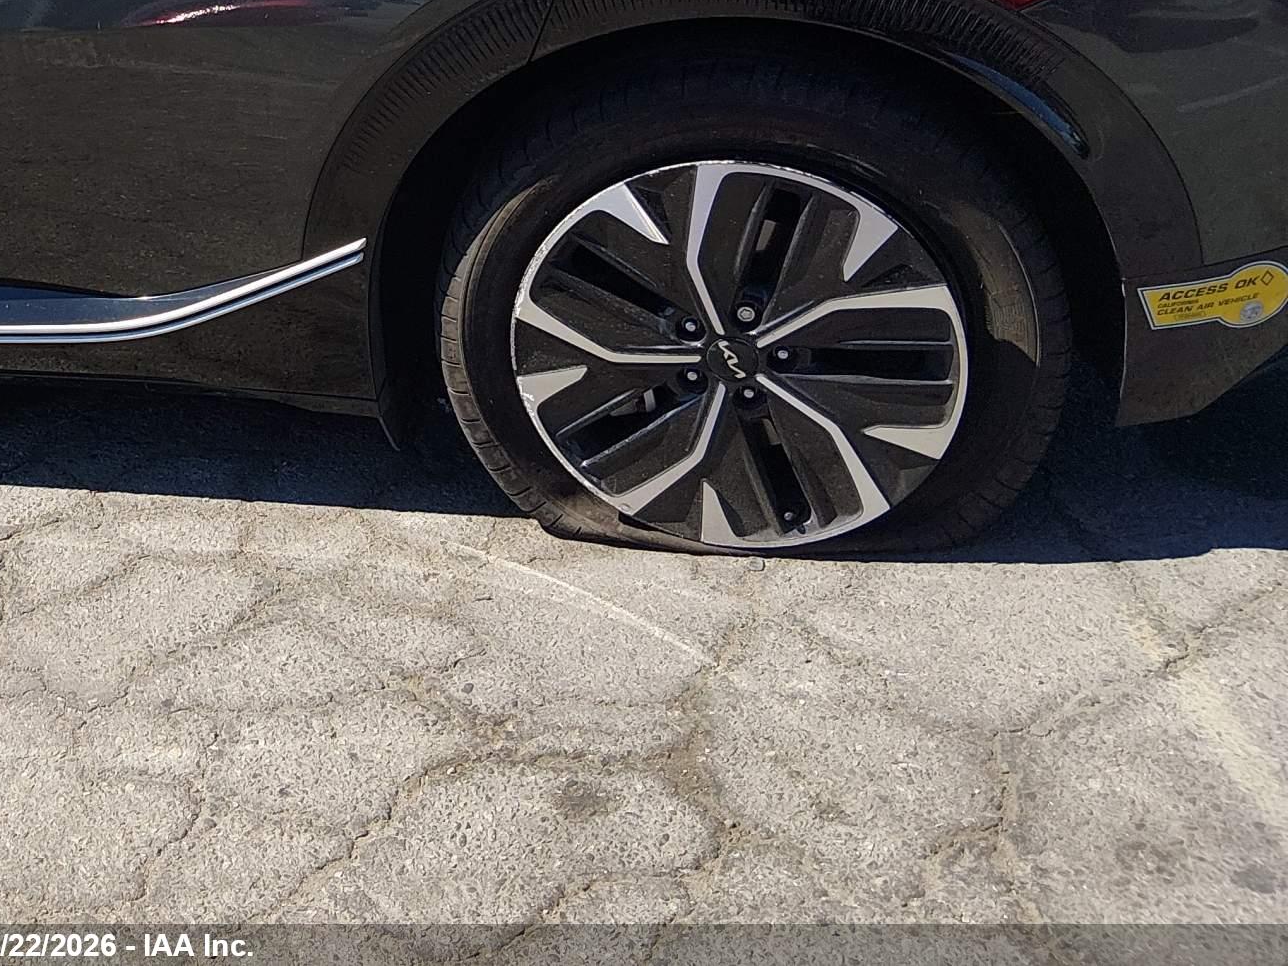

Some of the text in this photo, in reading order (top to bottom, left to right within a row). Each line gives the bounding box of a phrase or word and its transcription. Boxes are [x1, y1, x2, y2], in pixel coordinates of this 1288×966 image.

[1158, 275, 1261, 302] ACCESS OK
[1156, 305, 1193, 316] CLEAN
[1196, 301, 1215, 311] AIR
[1218, 292, 1260, 306] VEHICLE
